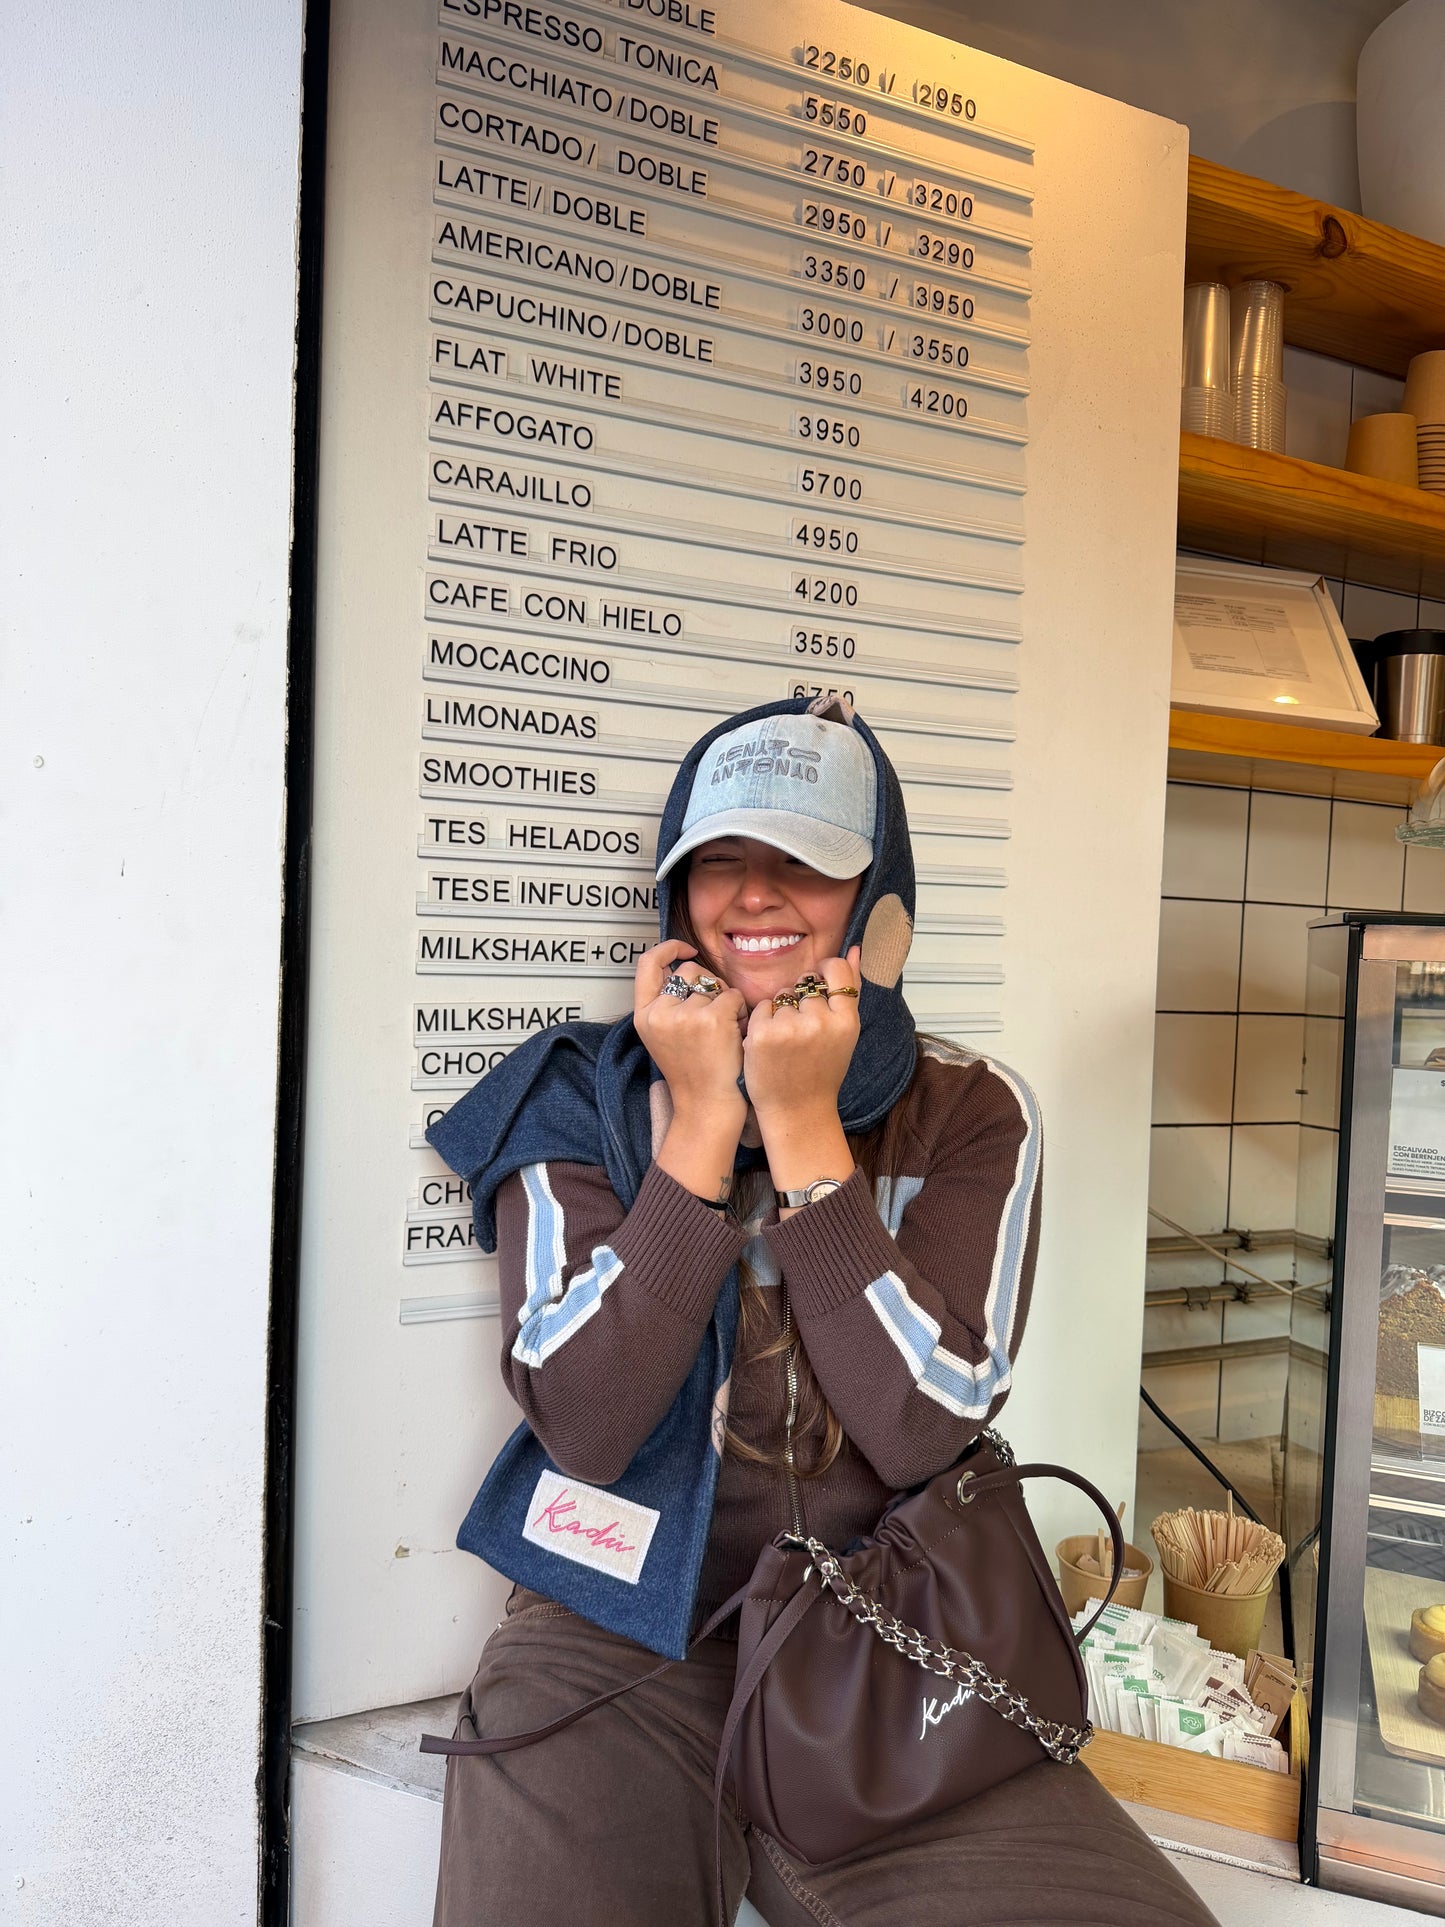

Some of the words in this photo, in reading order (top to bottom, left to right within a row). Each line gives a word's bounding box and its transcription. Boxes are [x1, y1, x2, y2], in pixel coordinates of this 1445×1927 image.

[443, 0, 603, 53] SPRESSO
[619, 36, 719, 91] TONICA
[805, 96, 866, 135] 5550
[806, 45, 870, 84] 2250
[888, 73, 896, 92] /
[920, 85, 976, 119] 2950
[618, 150, 707, 196] DOBLE
[805, 204, 866, 239] 2950
[883, 226, 891, 246] /
[918, 234, 974, 269] 3290
[804, 149, 866, 187] 2750
[887, 175, 895, 196] /
[915, 184, 973, 218] 3200
[804, 256, 866, 291] 3350
[889, 278, 899, 299] /
[916, 286, 974, 319] 3950
[801, 308, 863, 343] 3000
[887, 330, 895, 350] /
[912, 335, 969, 368] 3550
[435, 339, 506, 375] FLAT
[531, 358, 621, 399] WHITE
[799, 416, 860, 448] 3950
[799, 361, 862, 395] 3950
[910, 388, 968, 418] 4200
[434, 399, 593, 450] AFFOGATO
[801, 469, 862, 501] 5700
[433, 459, 591, 508] CARAJILLO
[796, 524, 858, 553] 4950
[438, 519, 527, 556] LATTE
[552, 537, 617, 570] FRIO
[795, 578, 858, 606] 4200
[429, 579, 508, 613] CAFE
[524, 593, 585, 624] CON
[603, 604, 682, 636] HIELO
[795, 631, 855, 659] 3550
[431, 639, 610, 684] MOCACCINO
[427, 698, 597, 739] LIMONADAS
[423, 758, 596, 796] SMOOTHIES
[711, 757, 818, 786] ANTONIO
[428, 818, 486, 845] TES
[509, 824, 640, 855] HELADOS
[421, 936, 658, 964] MILKSHAKE+CH
[417, 1006, 581, 1032] MILKSHAKE
[1393, 1145, 1438, 1154] ESCALIVADO
